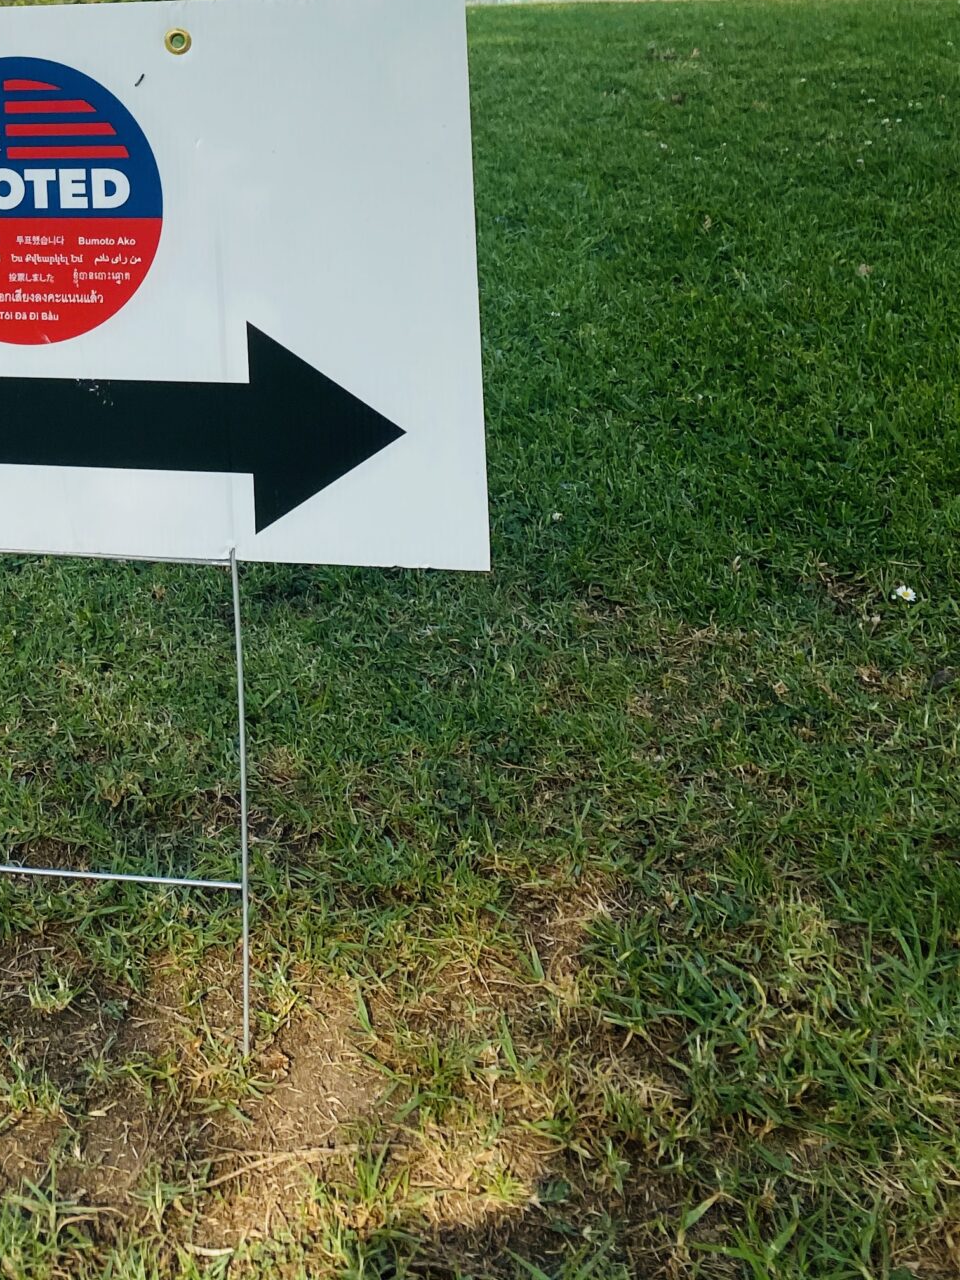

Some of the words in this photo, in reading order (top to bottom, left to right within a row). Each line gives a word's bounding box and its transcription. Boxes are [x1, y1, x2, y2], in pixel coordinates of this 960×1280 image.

[78, 236, 115, 246] Bumoto
[116, 236, 136, 246] Ako
[8, 272, 55, 283] 投票しました
